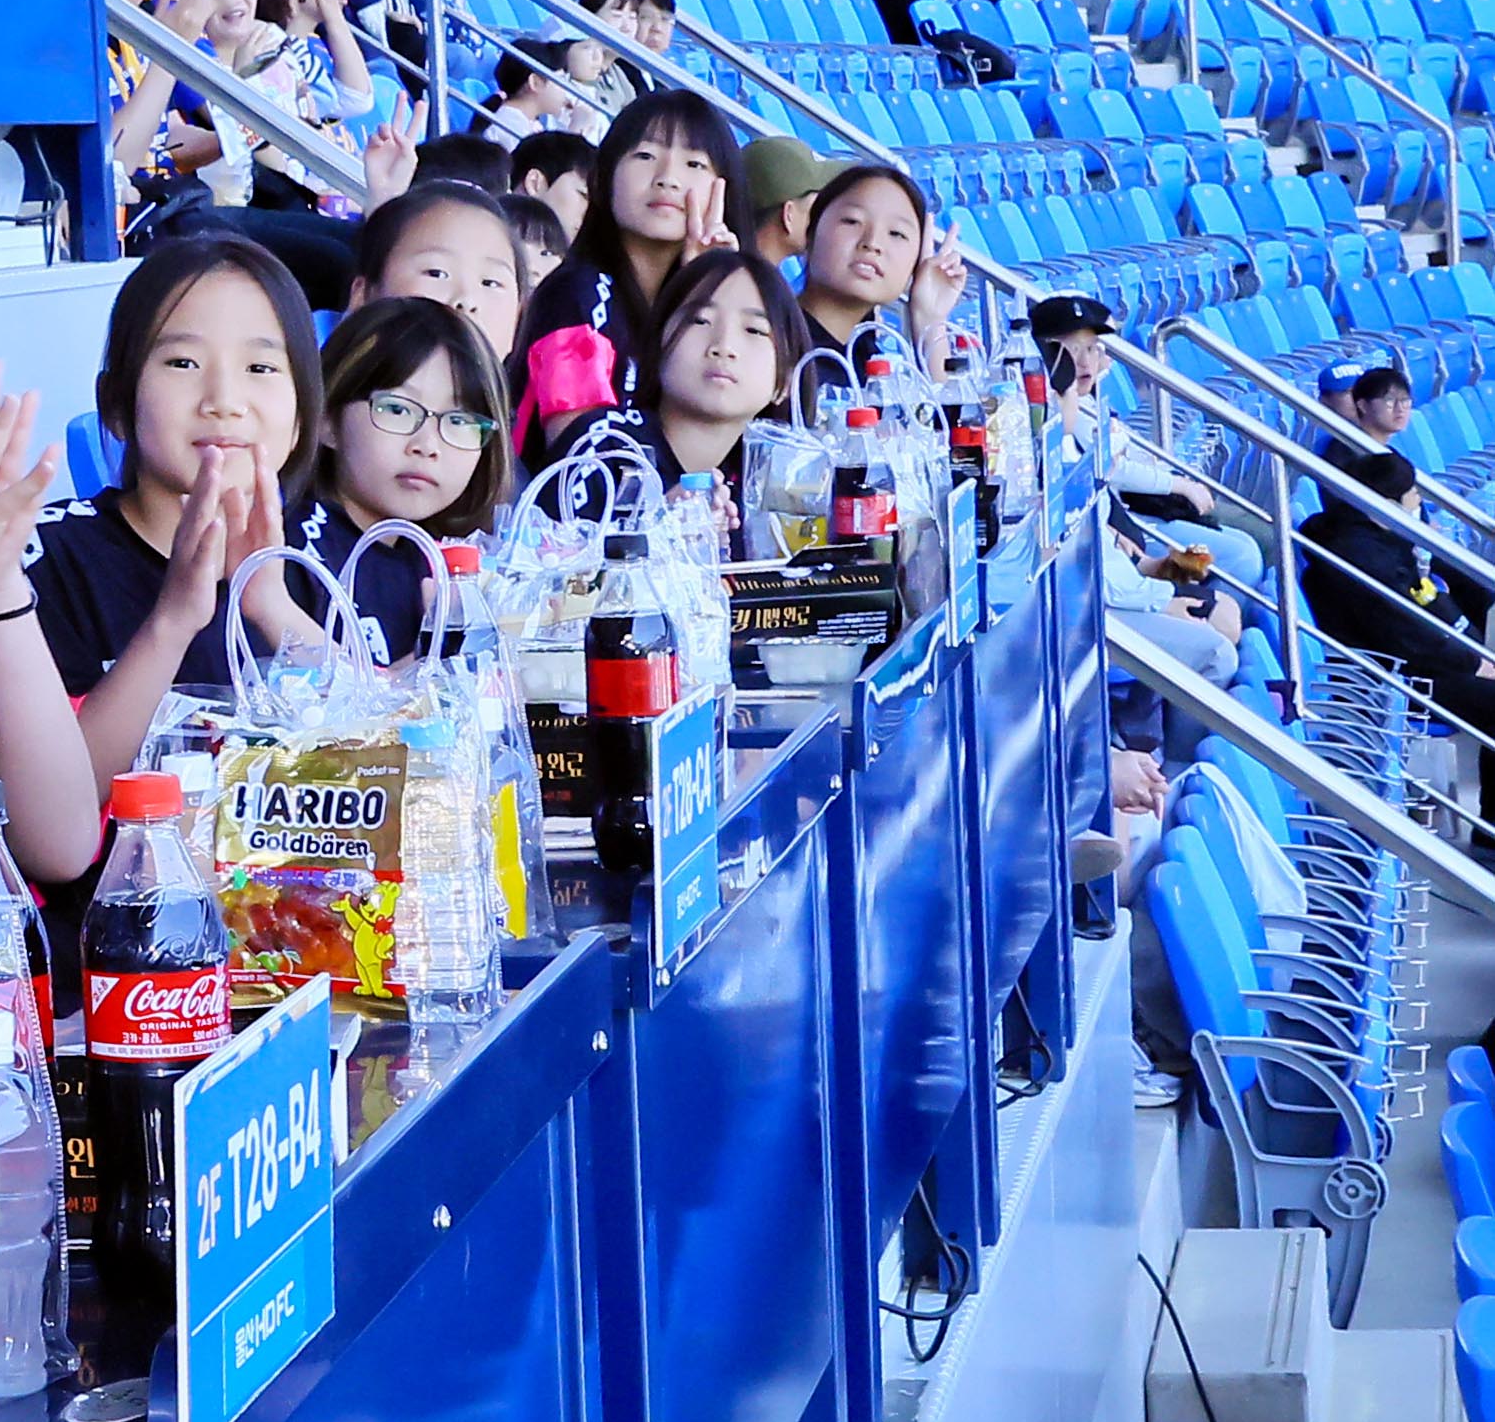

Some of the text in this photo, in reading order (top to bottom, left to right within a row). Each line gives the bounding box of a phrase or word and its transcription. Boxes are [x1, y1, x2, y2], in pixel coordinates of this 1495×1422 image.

[357, 766, 385, 777] Pocket
[672, 742, 711, 835] T28-C4
[235, 783, 385, 827] HARIBO
[249, 830, 369, 858] Goldbären
[124, 974, 226, 1022] Coca-Cola
[140, 1021, 192, 1031] ORIGINAL
[197, 1068, 321, 1260] 2F T28-B4
[235, 1280, 295, 1370] 울산 HD FC
